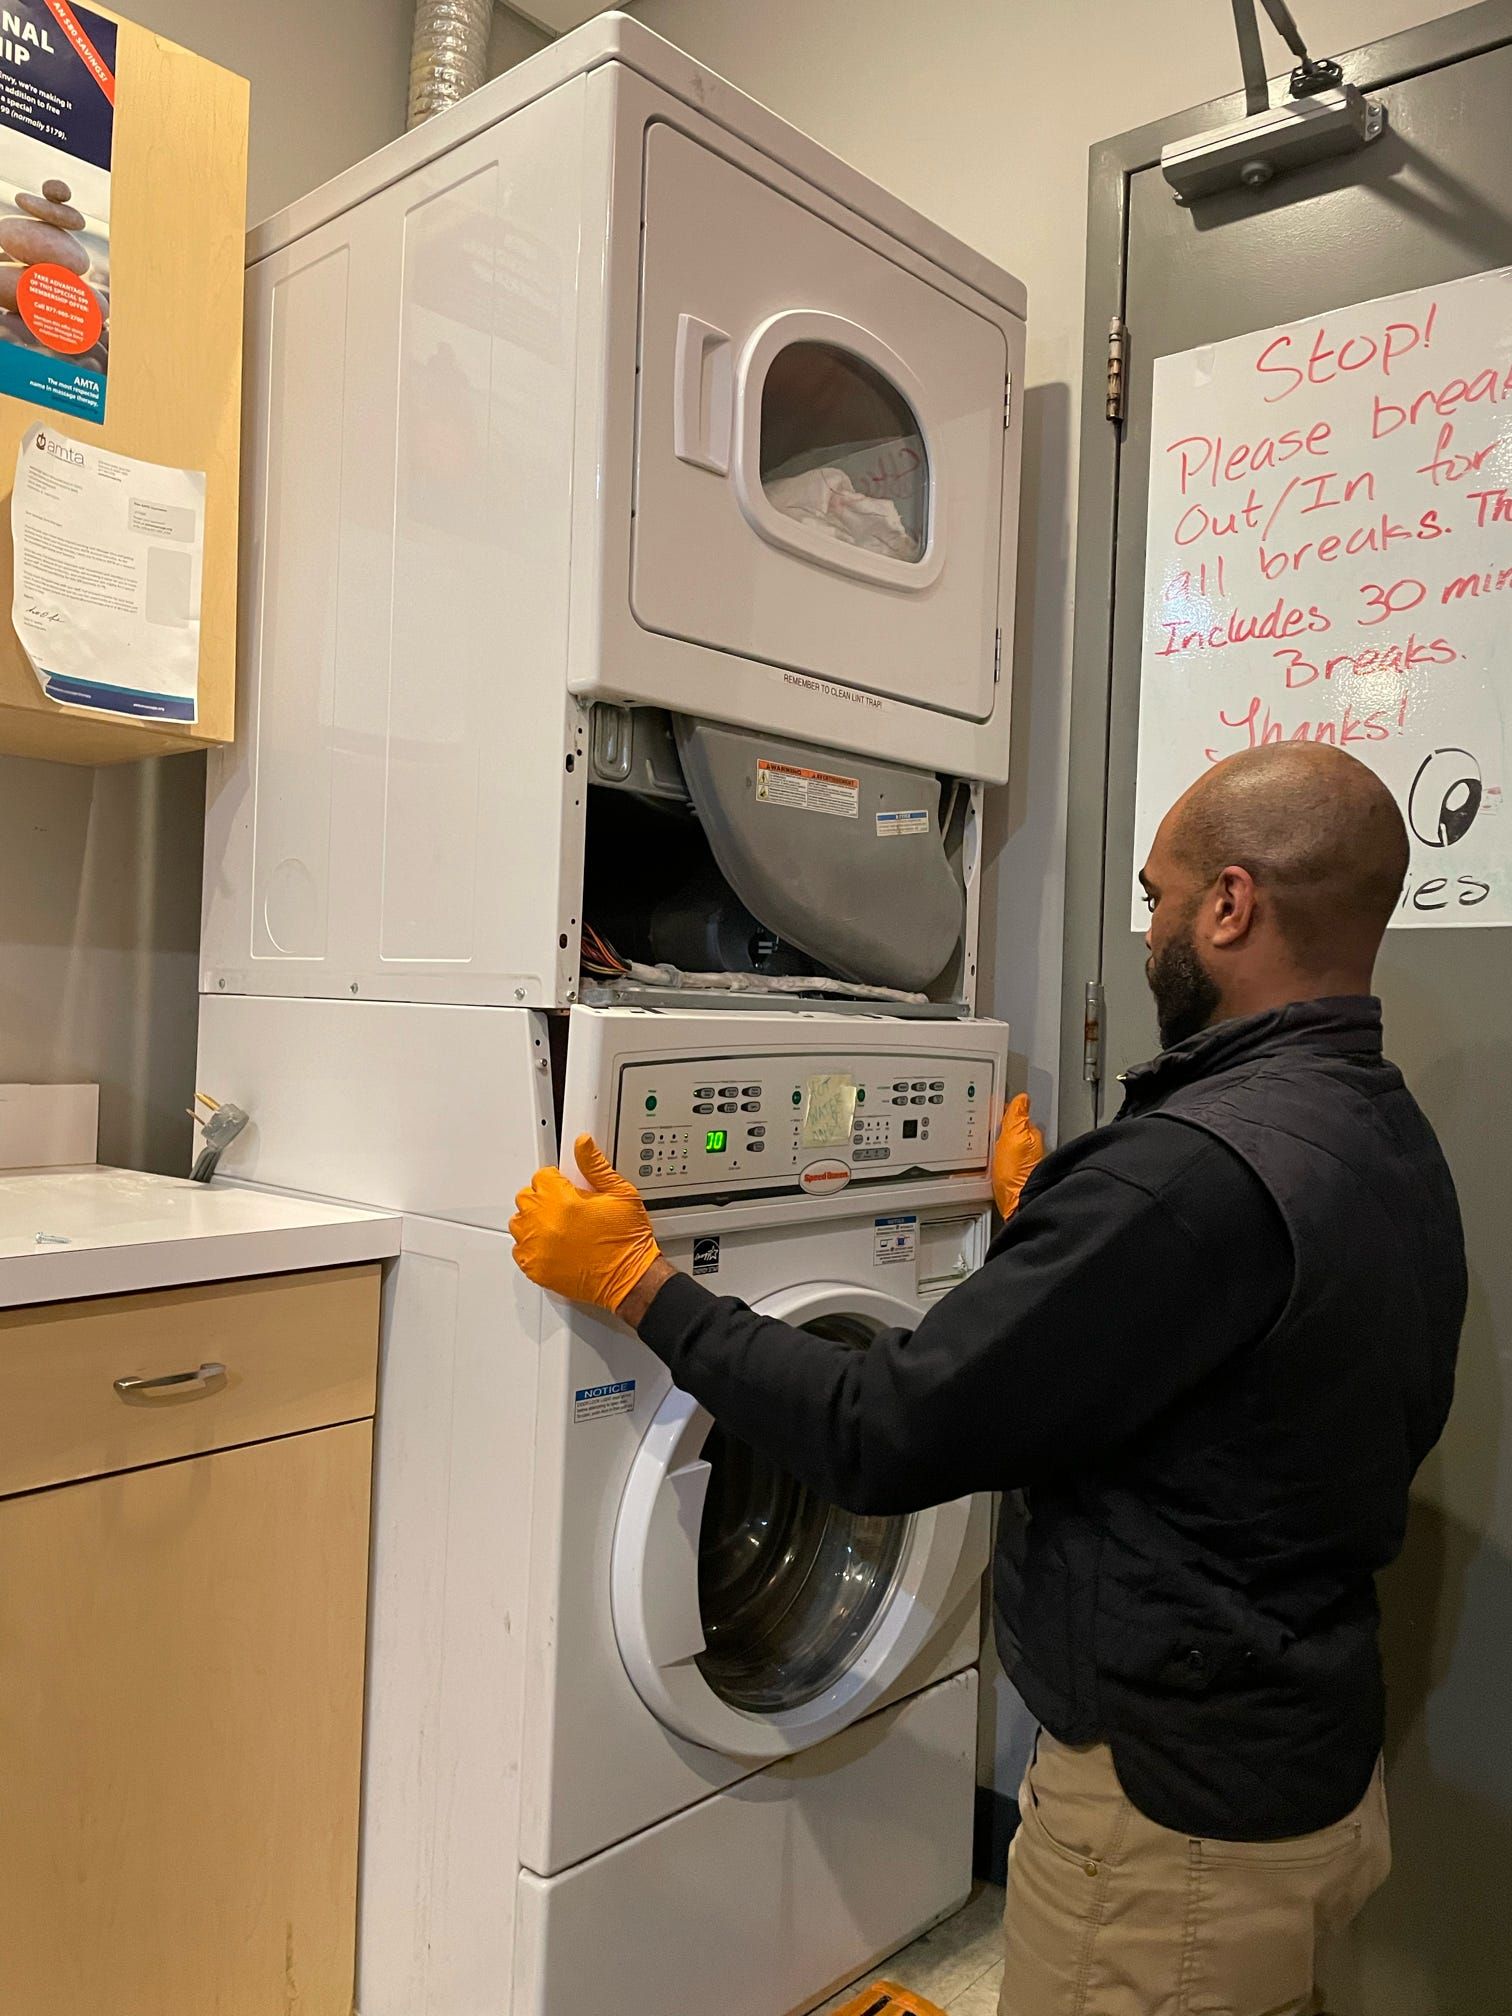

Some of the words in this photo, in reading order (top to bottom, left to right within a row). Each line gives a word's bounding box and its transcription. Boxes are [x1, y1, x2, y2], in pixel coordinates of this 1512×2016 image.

[2, 10, 55, 54] NAL
[0, 36, 30, 65] IP
[76, 37, 108, 82] SAVINGS!
[5, 85, 36, 105] addition
[37, 99, 45, 108] to
[46, 102, 60, 115] free
[7, 97, 32, 114] special
[18, 80, 38, 94] we're
[39, 89, 65, 108] making
[66, 100, 73, 110] it
[11, 109, 45, 131] (normally
[49, 279, 86, 297] ADVANTAGE
[1257, 303, 1437, 403] Stop!
[73, 376, 100, 393] AMTA
[47, 440, 85, 465] amta
[1166, 422, 1332, 494] Please
[1416, 421, 1500, 487] for
[1155, 598, 1331, 656] Includes
[1358, 579, 1427, 626] 30
[783, 673, 820, 691] REMEMBER
[820, 684, 830, 695] TO
[830, 687, 851, 700] CLEAN
[851, 693, 865, 704] LINT
[769, 762, 802, 776] WARNING
[584, 1383, 628, 1399] NOTICE
